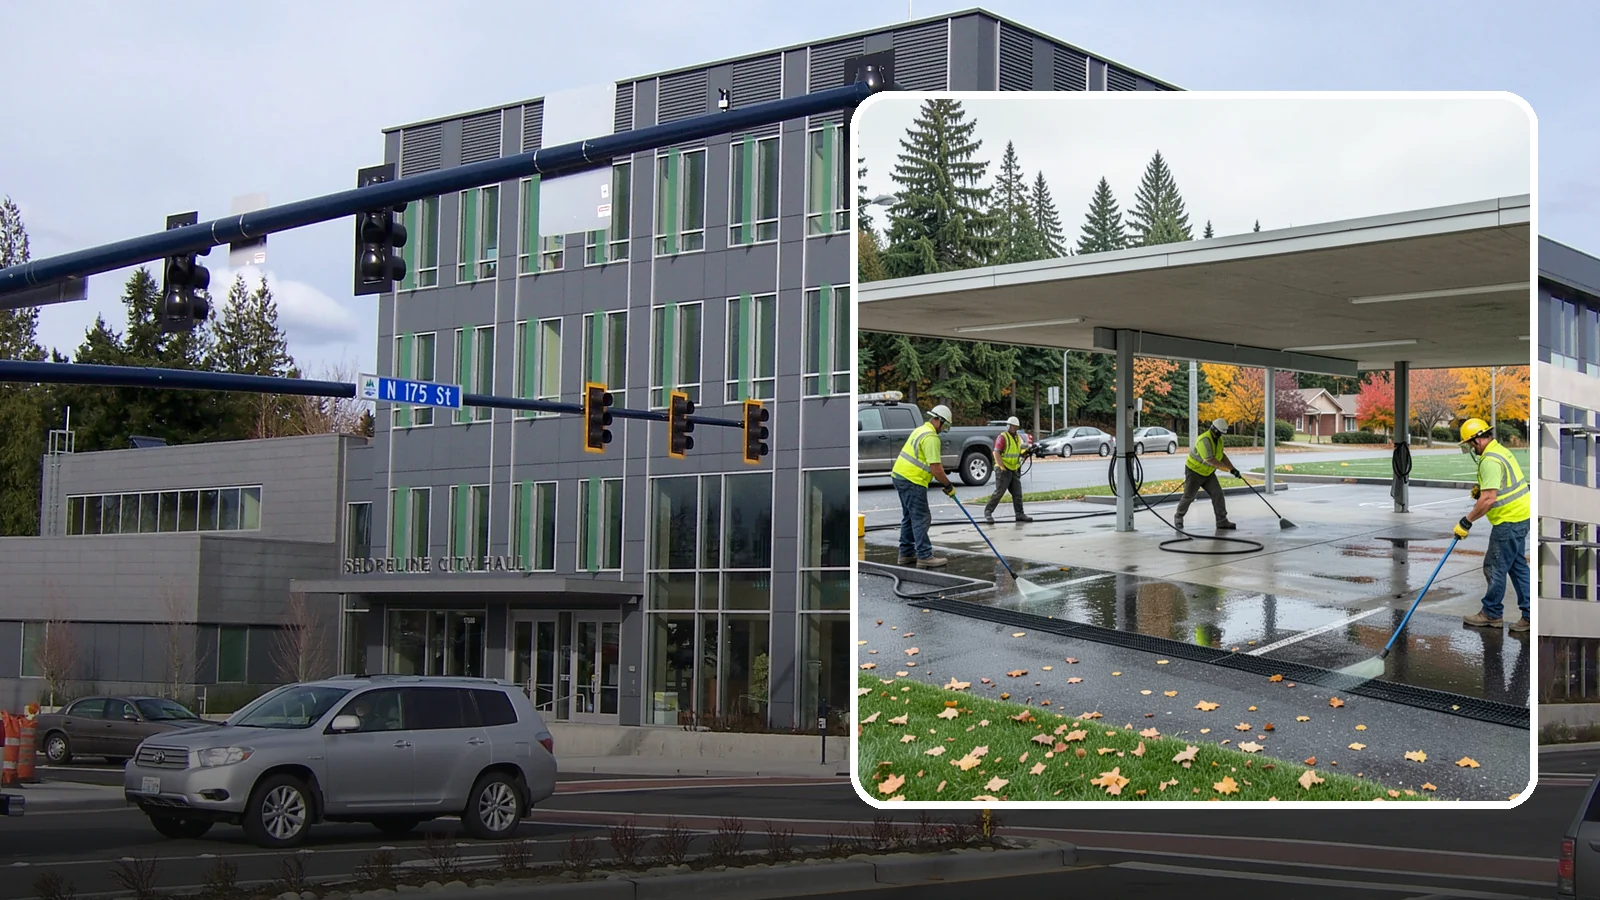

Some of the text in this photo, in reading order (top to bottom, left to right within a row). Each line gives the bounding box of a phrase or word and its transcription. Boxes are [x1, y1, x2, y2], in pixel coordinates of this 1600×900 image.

[387, 380, 451, 406] N 175 St
[344, 555, 526, 574] SHORELINE CITY HALL
